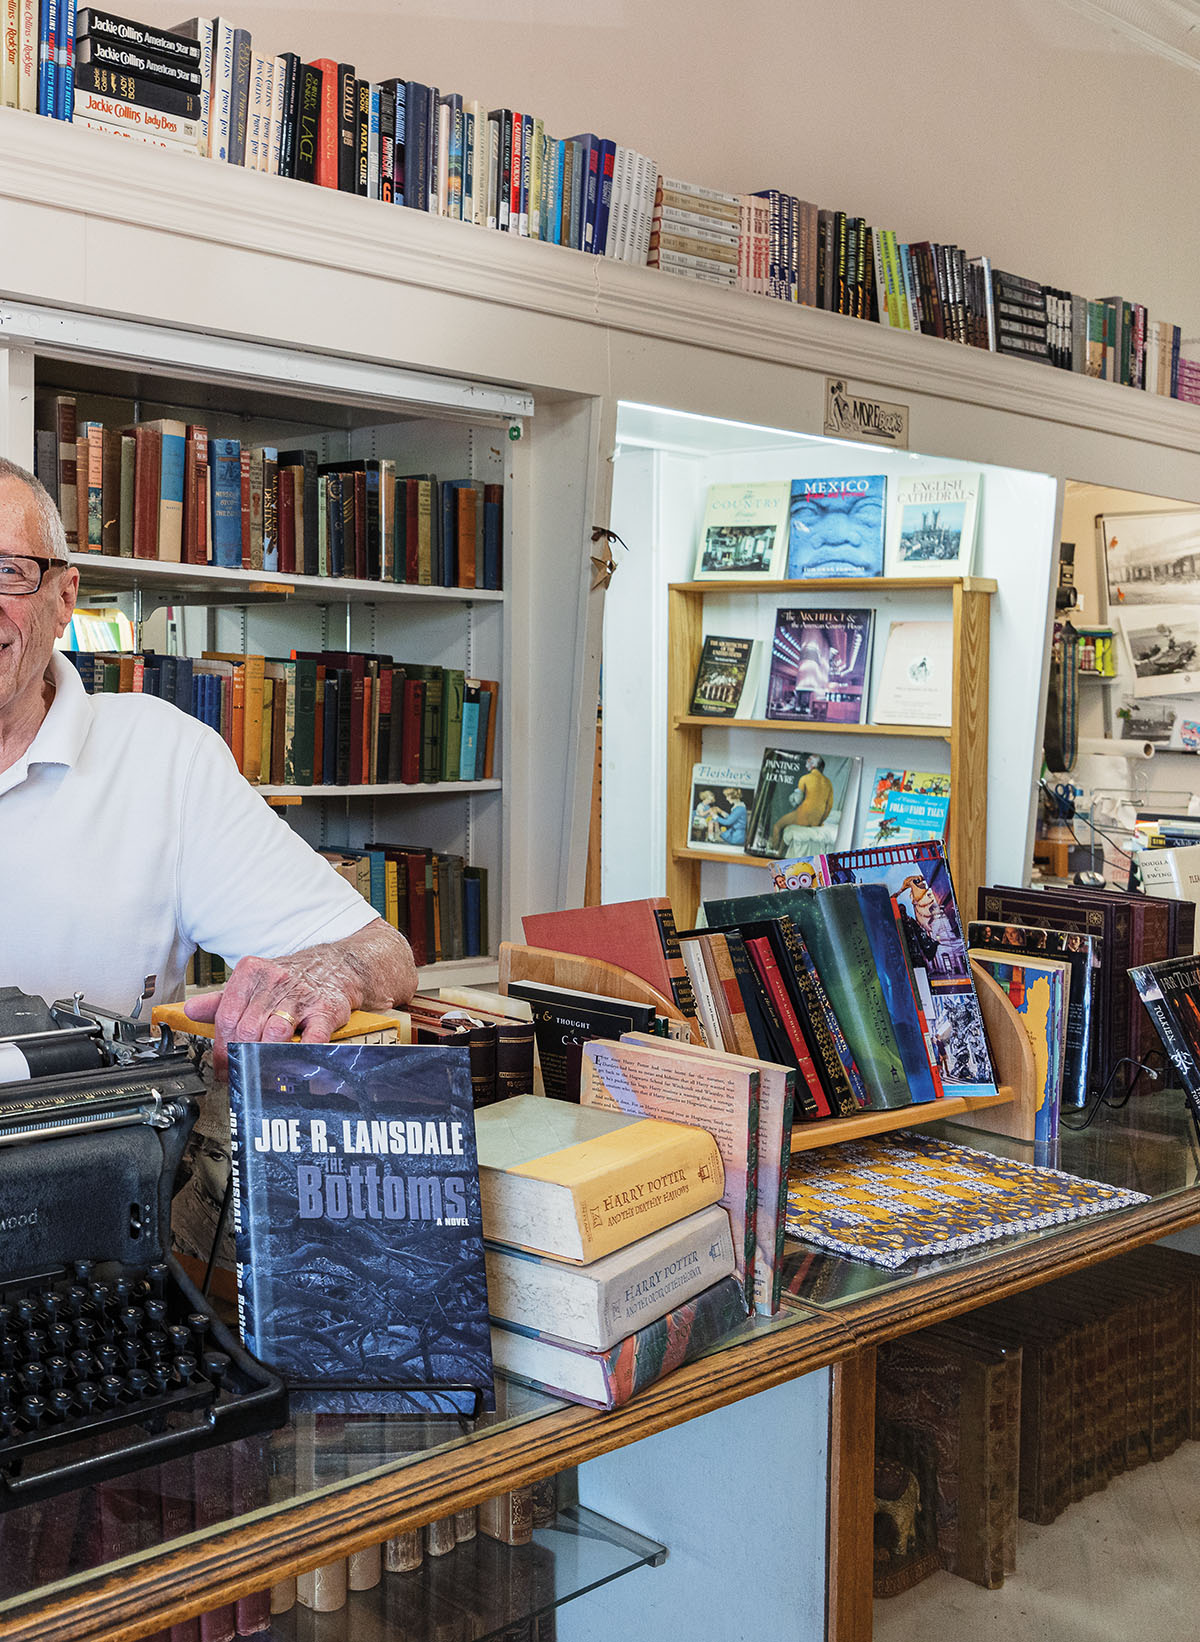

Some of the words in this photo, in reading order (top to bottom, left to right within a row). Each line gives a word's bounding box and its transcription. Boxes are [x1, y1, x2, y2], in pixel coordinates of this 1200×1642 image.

[23, 12, 34, 37] Collins
[49, 8, 57, 31] COLLINS
[67, 11, 75, 36] COLLINS
[91, 16, 118, 36] Jackie
[118, 24, 143, 43] Collins
[144, 33, 176, 51] American
[175, 42, 190, 55] Star
[94, 44, 120, 62] Jackie
[120, 51, 145, 70] Collins
[146, 60, 176, 78] American
[176, 68, 191, 82] Star
[120, 76, 128, 97] LADY
[303, 72, 313, 111] CONRAN
[310, 79, 318, 109] SHIRLEY
[326, 84, 335, 113] BODY
[345, 76, 354, 118] TOXIN
[85, 96, 114, 115] Jackie
[114, 104, 141, 123] Collins
[144, 112, 162, 129] Lady
[161, 117, 177, 132] Boss
[299, 116, 315, 164] LACE
[326, 128, 336, 159] SOUL
[360, 123, 368, 153] FATAL
[513, 122, 521, 156] CATHERINE
[523, 124, 532, 158] CATHERINE
[382, 136, 393, 180] CHROMOSOME
[512, 157, 521, 187] COOKSON
[523, 159, 531, 189] COOKSON
[911, 301, 919, 331] SCARPETTA
[853, 400, 880, 428] MORE
[804, 480, 870, 494] MEXICO
[897, 490, 976, 504] CATHEDRALS
[911, 479, 964, 493] ENGLISH
[711, 498, 779, 510] COUNTRY
[765, 759, 801, 771] PAINTINGS
[765, 773, 795, 784] LOUVRE
[889, 803, 904, 813] FOLK
[1141, 860, 1169, 868] DOUGLA
[1160, 976, 1178, 993] JRR
[1173, 968, 1200, 990] TOLK
[556, 1017, 590, 1030] THOUGHT
[870, 985, 891, 1045] POTTER
[1154, 1005, 1176, 1042] TOLKIEN
[229, 1107, 238, 1137] JOE
[255, 1119, 301, 1153] JOE
[311, 1119, 336, 1153] R.
[343, 1120, 464, 1155] LANSDALE
[230, 1140, 238, 1155] R.
[325, 1157, 344, 1173] THE
[231, 1158, 243, 1234] LANSDALE
[298, 1164, 468, 1221] Bottoms
[603, 1183, 645, 1211] HARRY
[648, 1168, 687, 1194] POTTER
[635, 1196, 663, 1217] DEATHLY
[663, 1184, 690, 1203] HALLOWS
[436, 1217, 443, 1226] A
[445, 1217, 470, 1227] NOVEL
[624, 1270, 663, 1302] HARRY
[663, 1250, 699, 1278] POTTER
[237, 1293, 246, 1348] Botto
